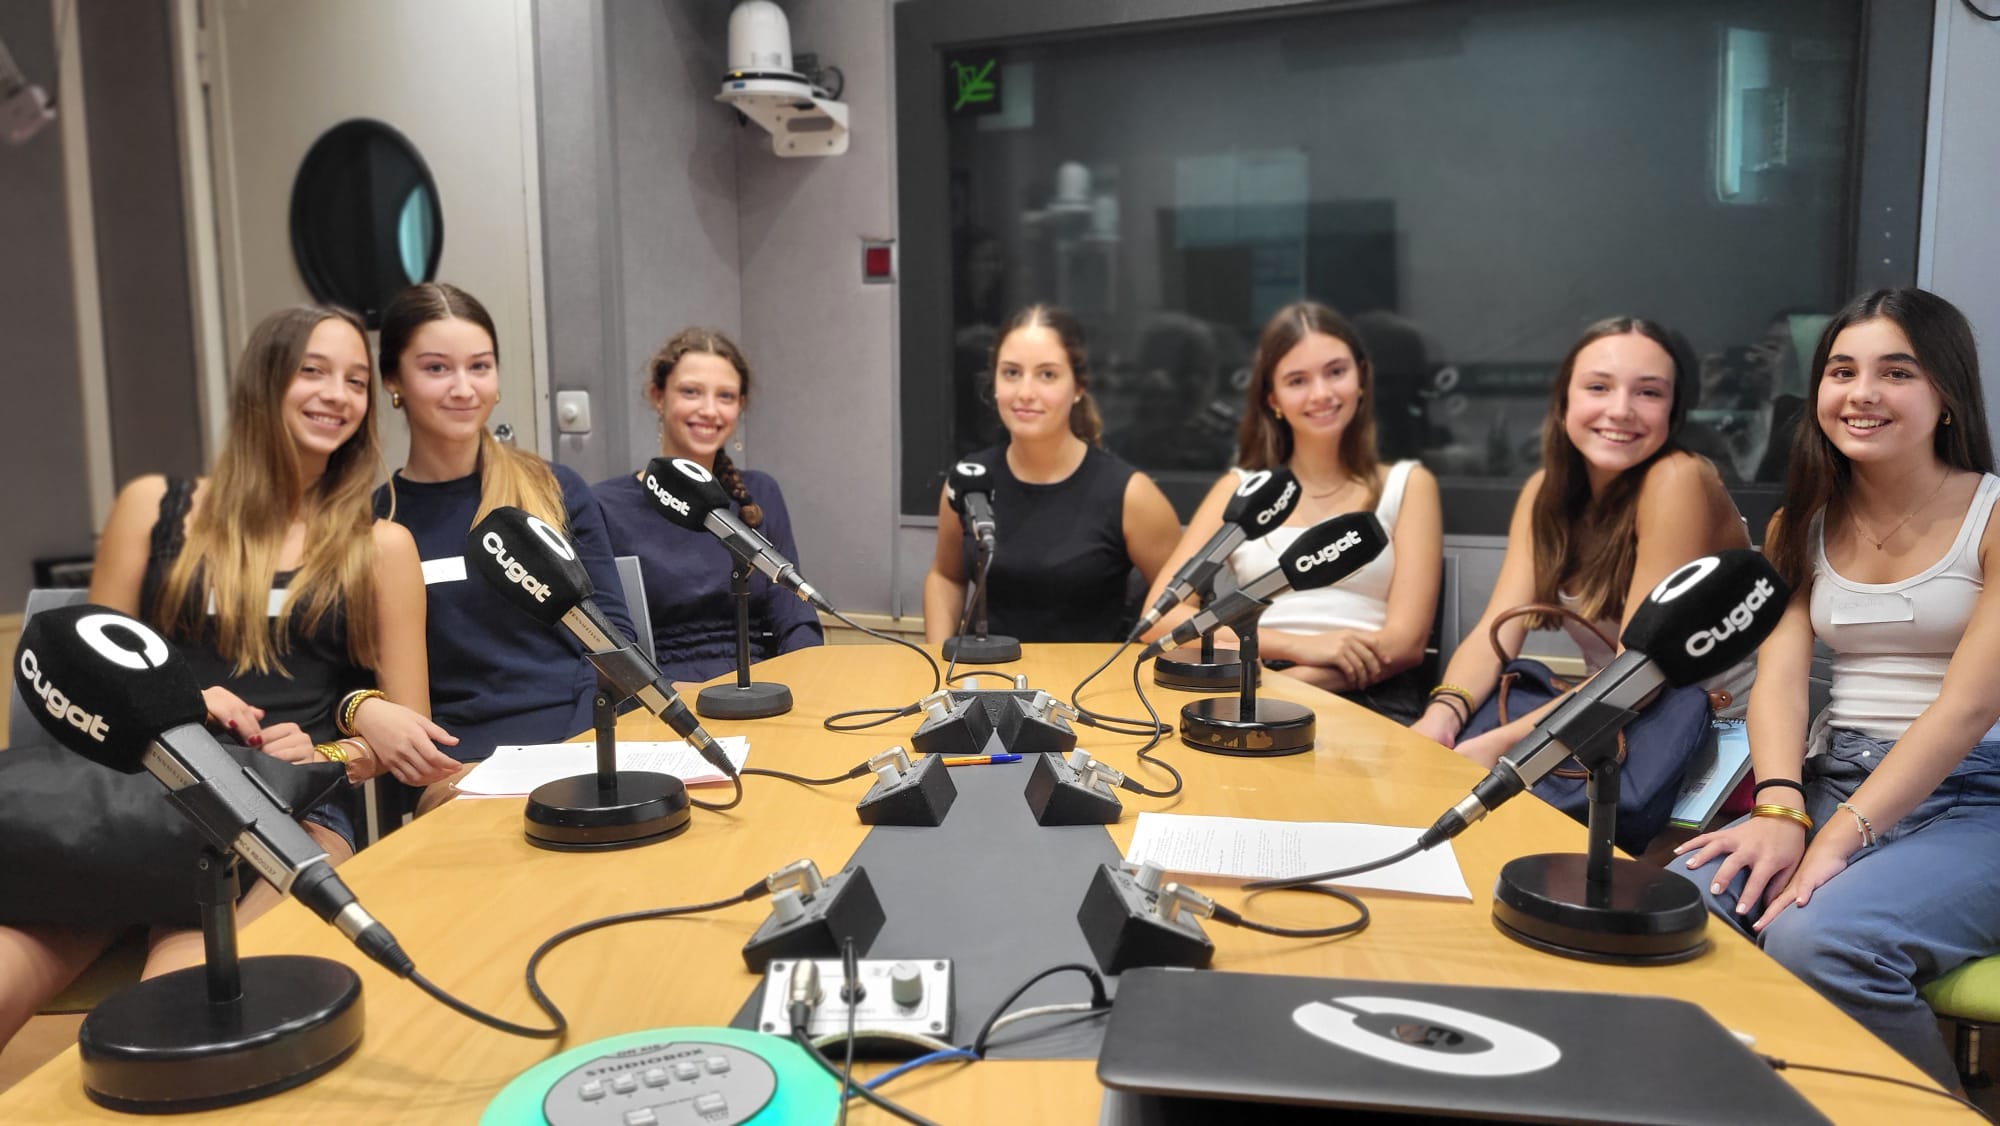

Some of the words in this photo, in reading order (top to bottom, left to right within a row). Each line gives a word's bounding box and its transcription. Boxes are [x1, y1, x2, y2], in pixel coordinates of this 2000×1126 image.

[646, 474, 691, 517] Cugat
[1256, 480, 1297, 525] Cugat
[482, 531, 552, 603] Cugat
[1295, 530, 1362, 573] Cugat
[1685, 577, 1775, 657] Cugat
[20, 648, 110, 742] Cugat
[585, 1048, 704, 1077] STUDIOBOX
